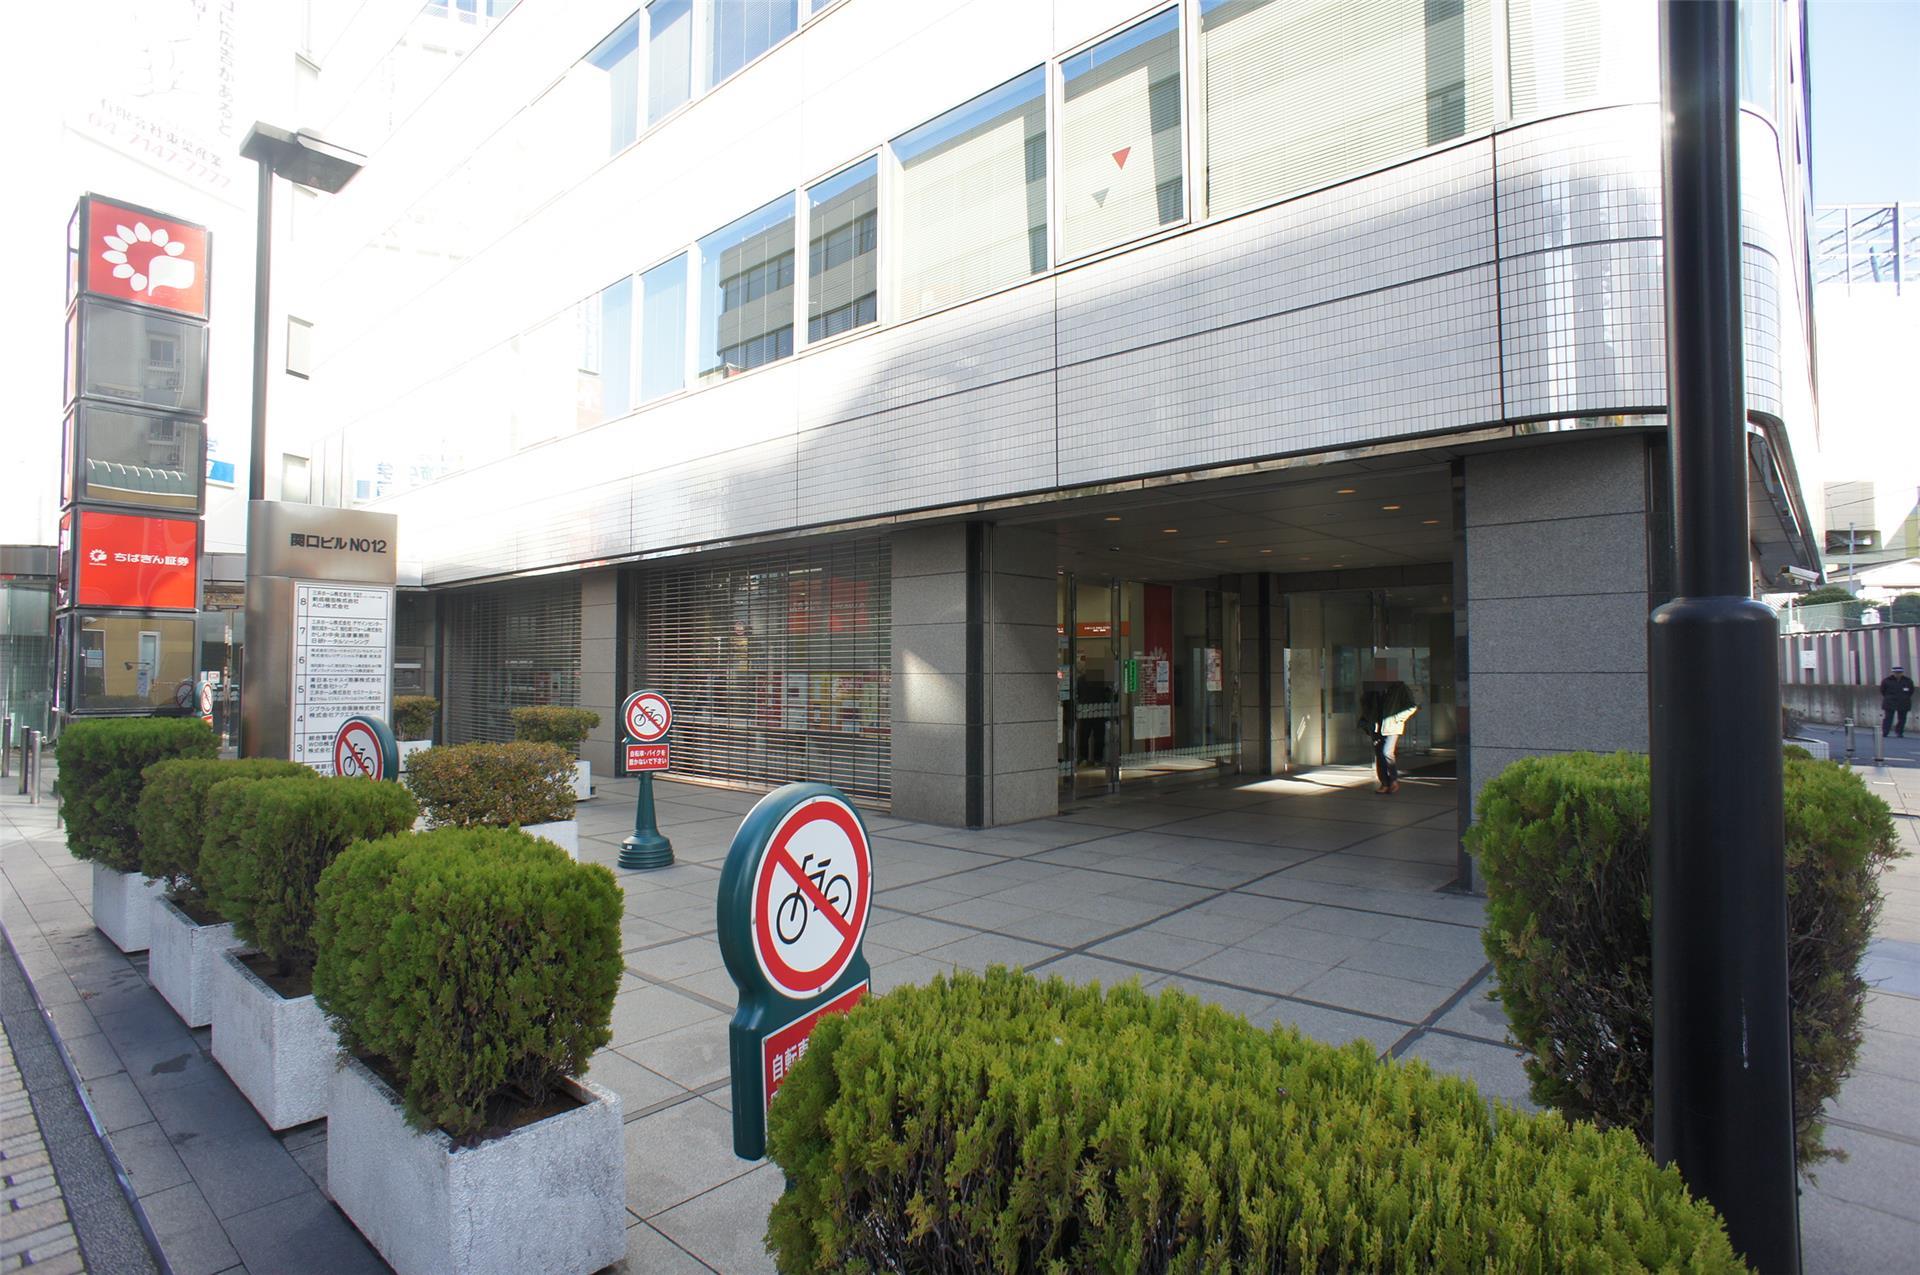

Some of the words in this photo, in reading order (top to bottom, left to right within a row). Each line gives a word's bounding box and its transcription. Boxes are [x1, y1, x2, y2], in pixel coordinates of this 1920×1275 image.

[114, 552, 189, 566] ちばぎん証券
[300, 597, 307, 605] 8
[298, 656, 305, 664] 6
[297, 685, 304, 693] 5
[296, 744, 303, 752] 3
